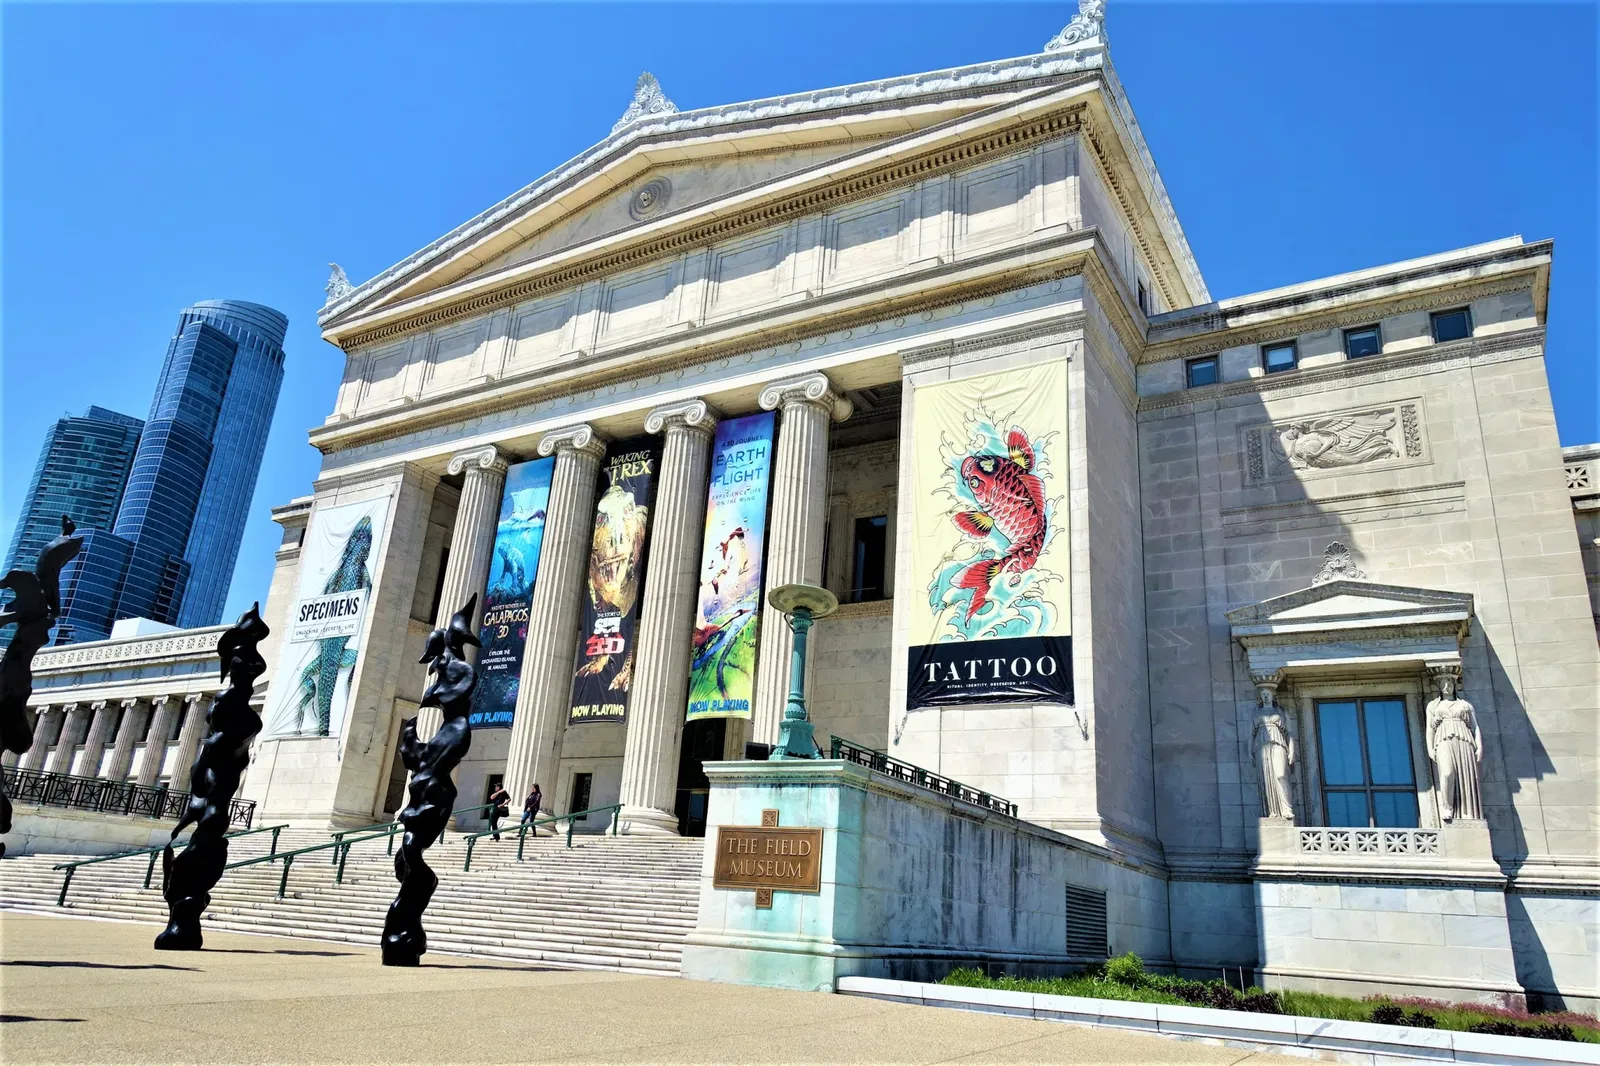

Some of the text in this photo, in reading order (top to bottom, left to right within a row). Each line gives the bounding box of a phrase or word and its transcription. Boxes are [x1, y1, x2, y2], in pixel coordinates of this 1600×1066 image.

[735, 434, 764, 446] JOURNEY
[611, 450, 651, 466] WAKING
[716, 446, 766, 467] EARTH
[713, 467, 764, 487] FLIGHT
[712, 490, 747, 500] EXPERIENCE
[299, 597, 360, 622] SPECIMENS
[483, 608, 529, 627] GALAPAGOS
[497, 625, 509, 639] 3D
[924, 655, 1057, 683] TATTOO
[571, 703, 625, 718] NOW PLAYING
[689, 698, 749, 714] NOW PLAYING
[484, 711, 514, 723] PLAYING
[726, 838, 812, 857] THE FIELD
[729, 860, 804, 878] MUSEUM
